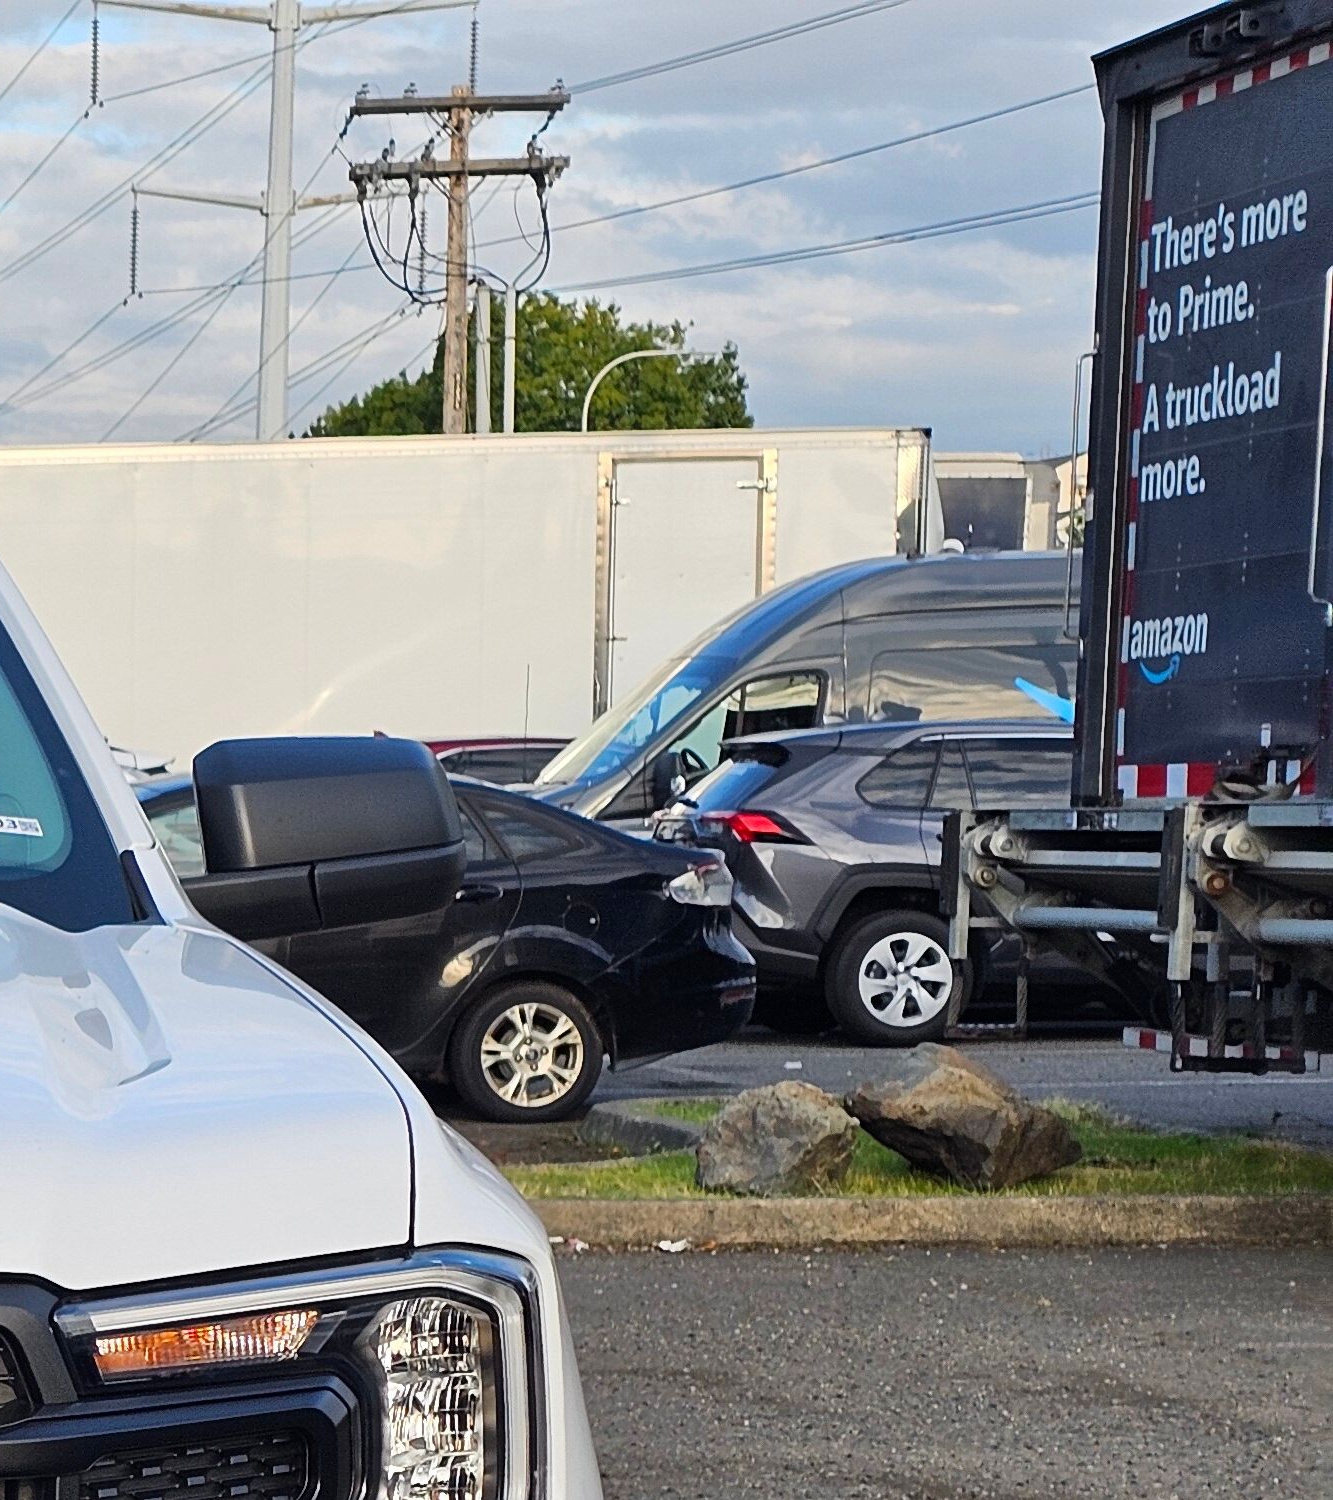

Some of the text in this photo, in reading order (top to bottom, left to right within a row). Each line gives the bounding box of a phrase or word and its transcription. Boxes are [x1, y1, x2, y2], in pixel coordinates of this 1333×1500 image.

[1151, 189, 1308, 272] There's more
[1147, 274, 1255, 344] to Prime.
[1142, 351, 1282, 434] A truckload
[1140, 455, 1206, 502] more.
[1130, 612, 1209, 660] amazon
